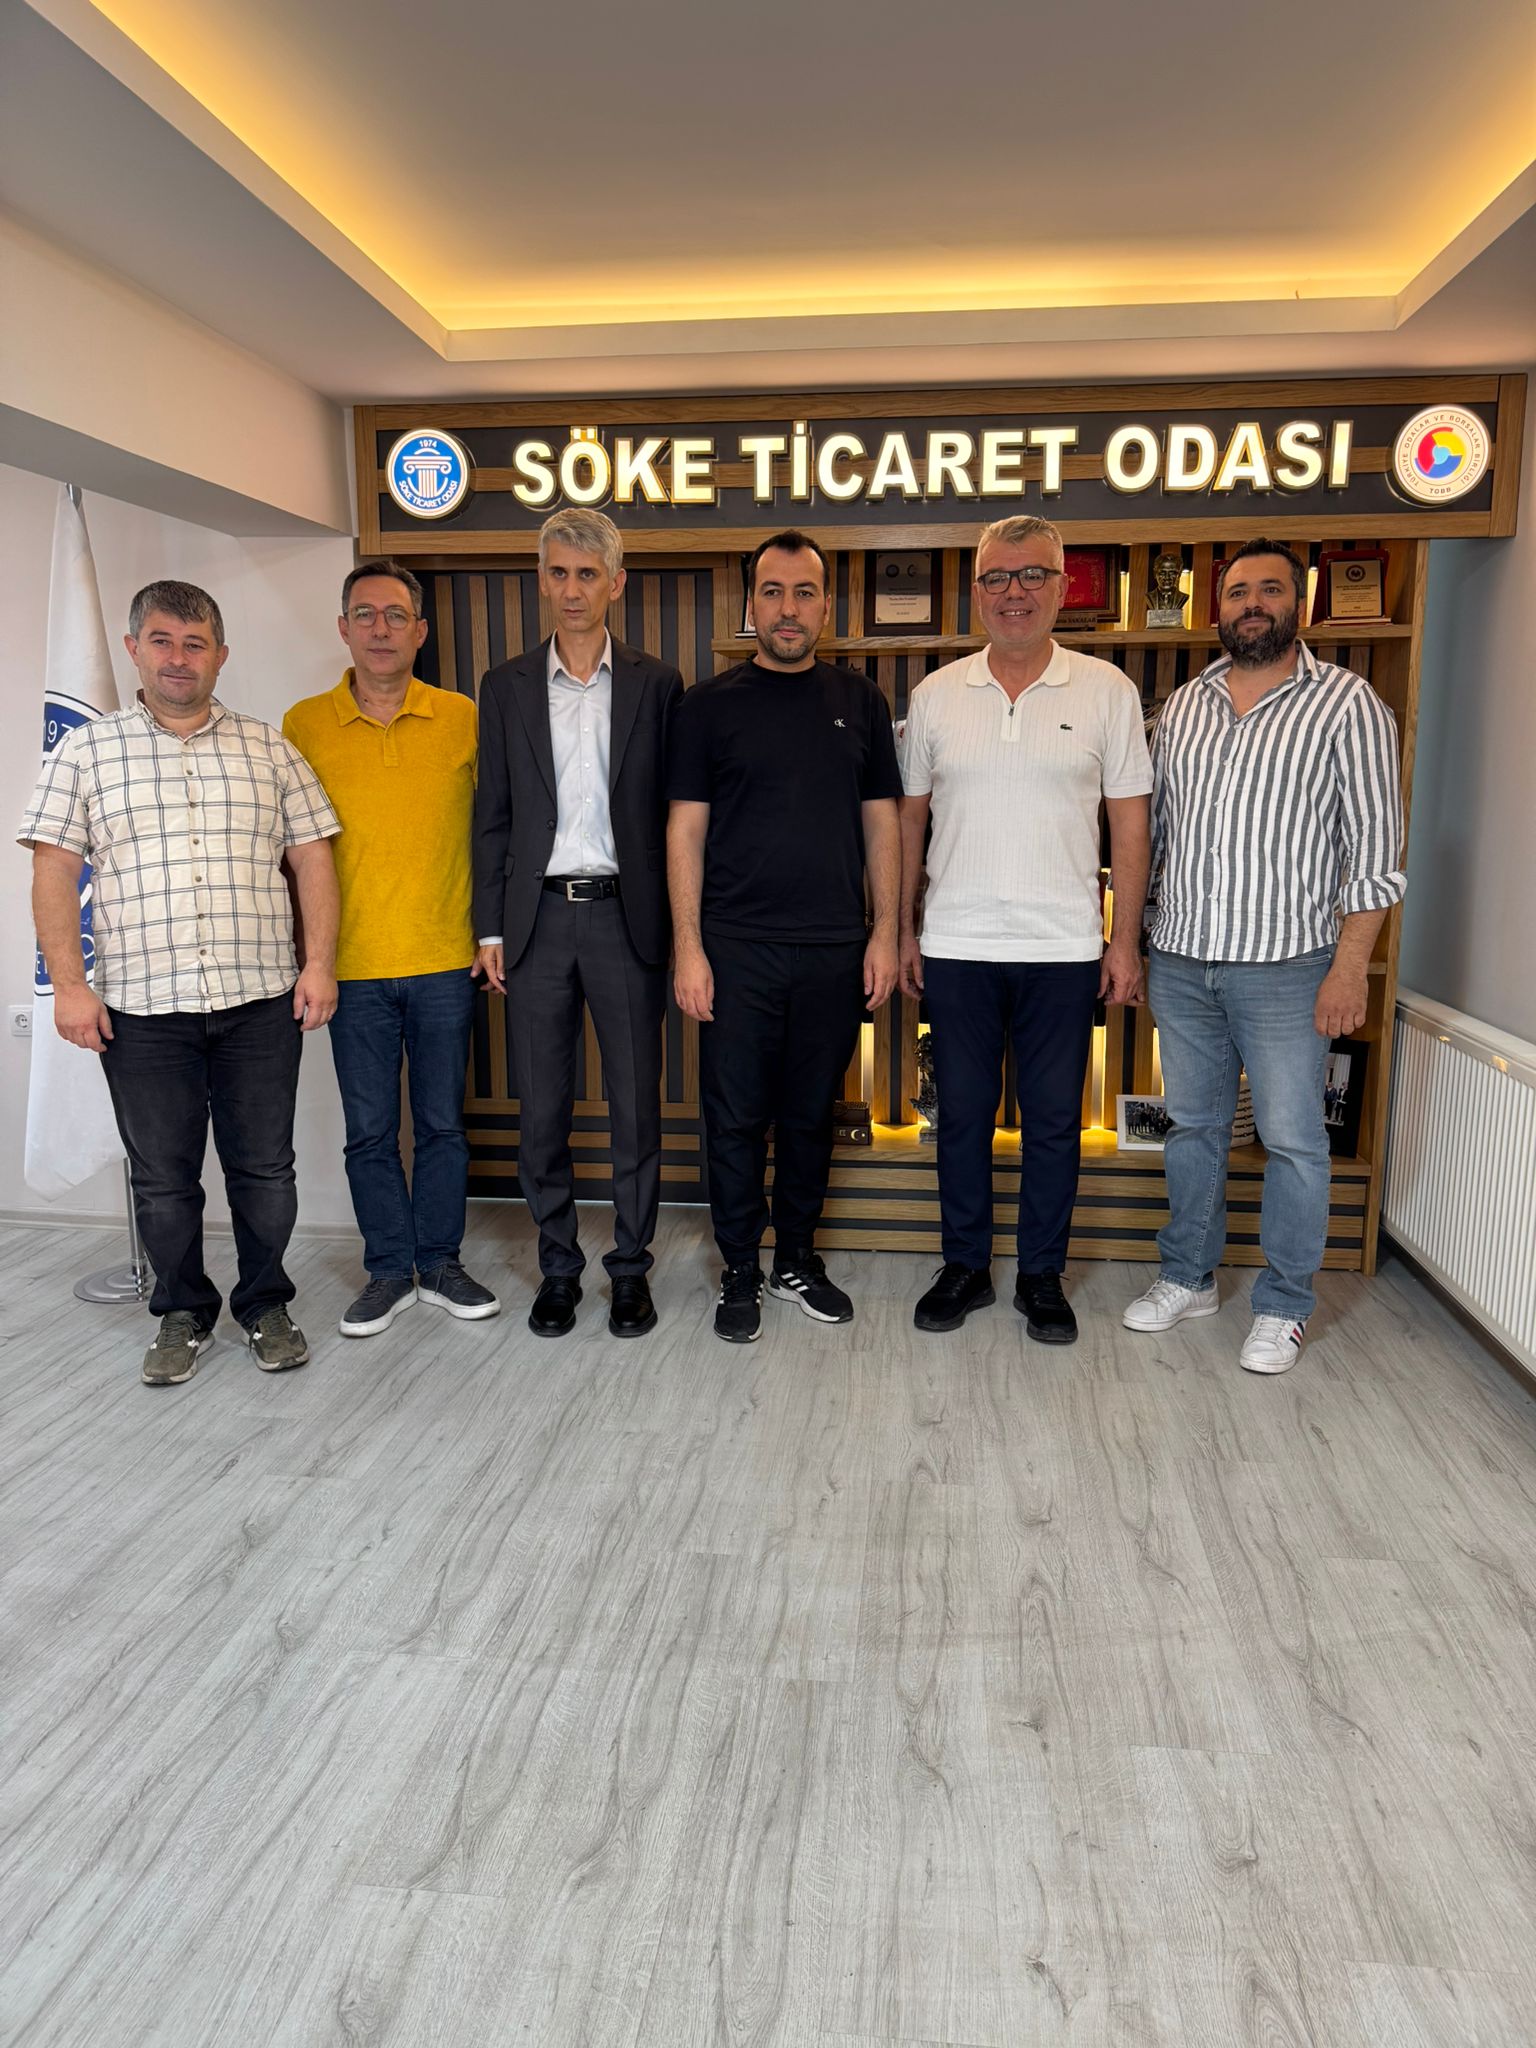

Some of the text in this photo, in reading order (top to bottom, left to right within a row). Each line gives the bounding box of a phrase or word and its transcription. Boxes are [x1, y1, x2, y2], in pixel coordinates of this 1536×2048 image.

[419, 439, 438, 448] 1974
[1404, 418, 1430, 449] ODALAR
[1449, 415, 1481, 449] BORSALAR
[513, 421, 1351, 503] SÖKE TİCARET ODASI
